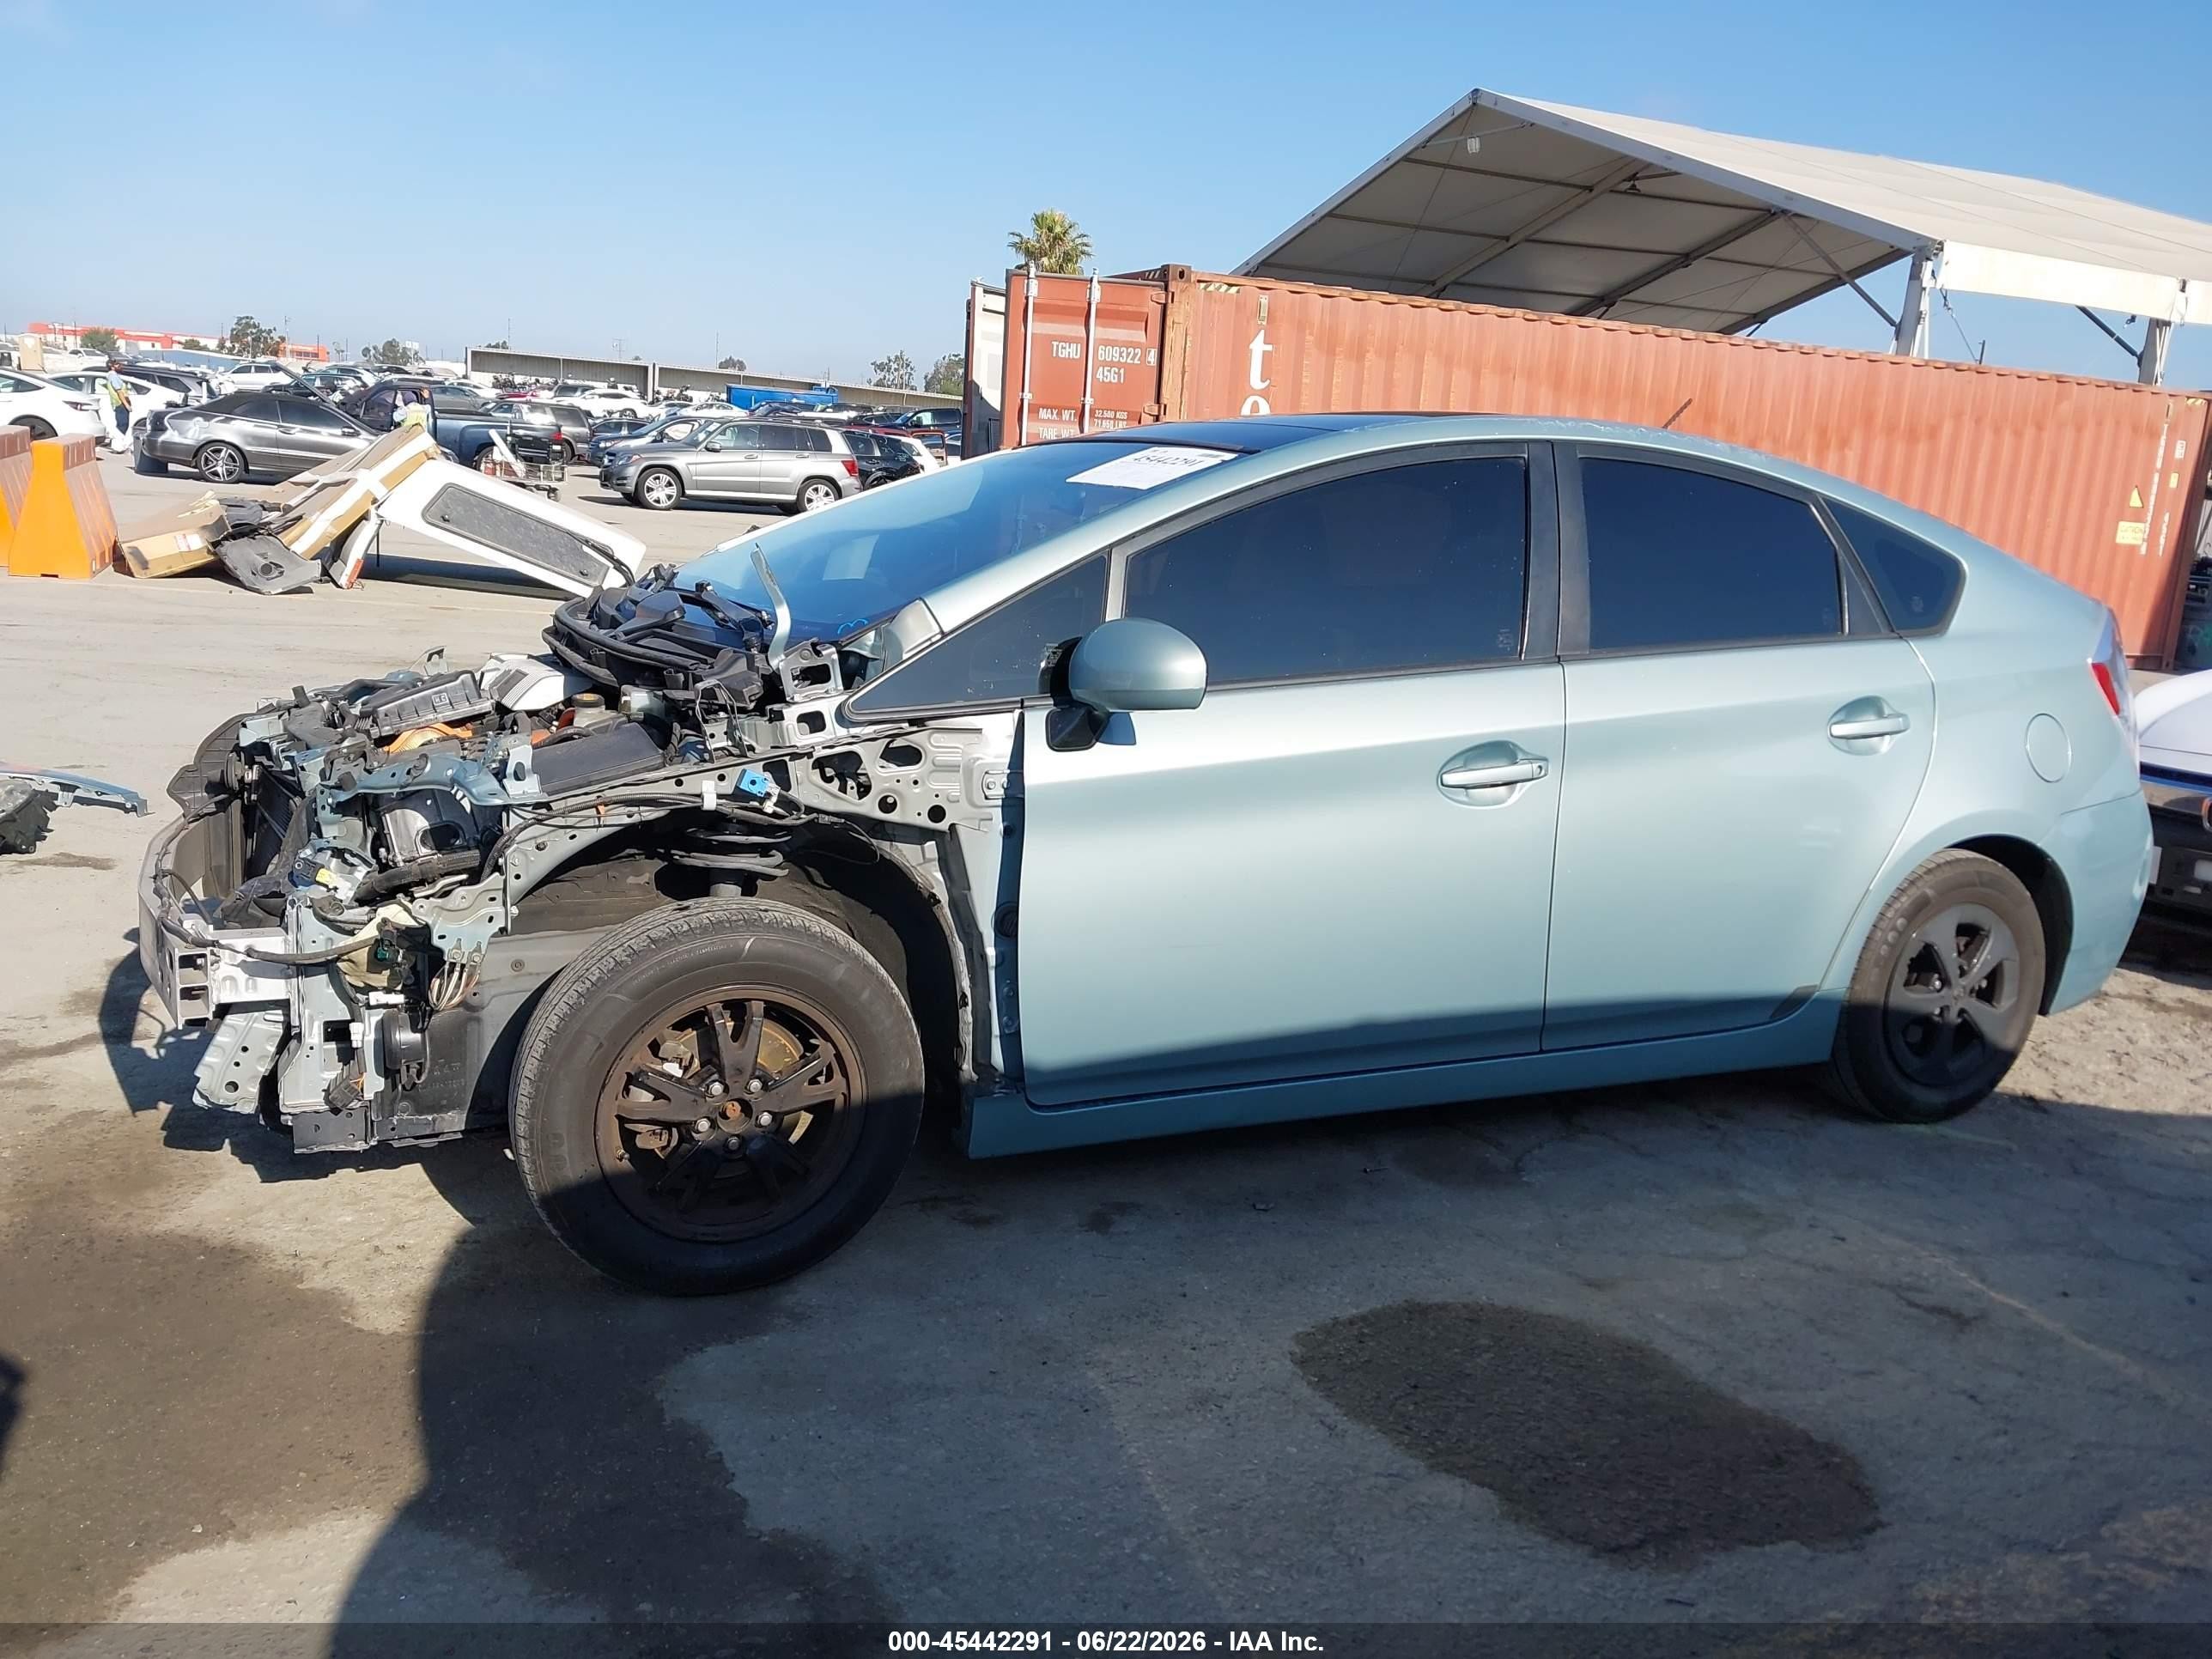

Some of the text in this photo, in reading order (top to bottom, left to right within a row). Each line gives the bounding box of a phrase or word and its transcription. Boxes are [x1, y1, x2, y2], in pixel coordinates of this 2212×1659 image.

[1052, 341, 1156, 365] TGHU 609322 4
[1096, 366, 1125, 384] 45G1
[1038, 408, 1060, 421] MAX.
[1062, 410, 1078, 422] WT.
[1038, 427, 1057, 441] TARE
